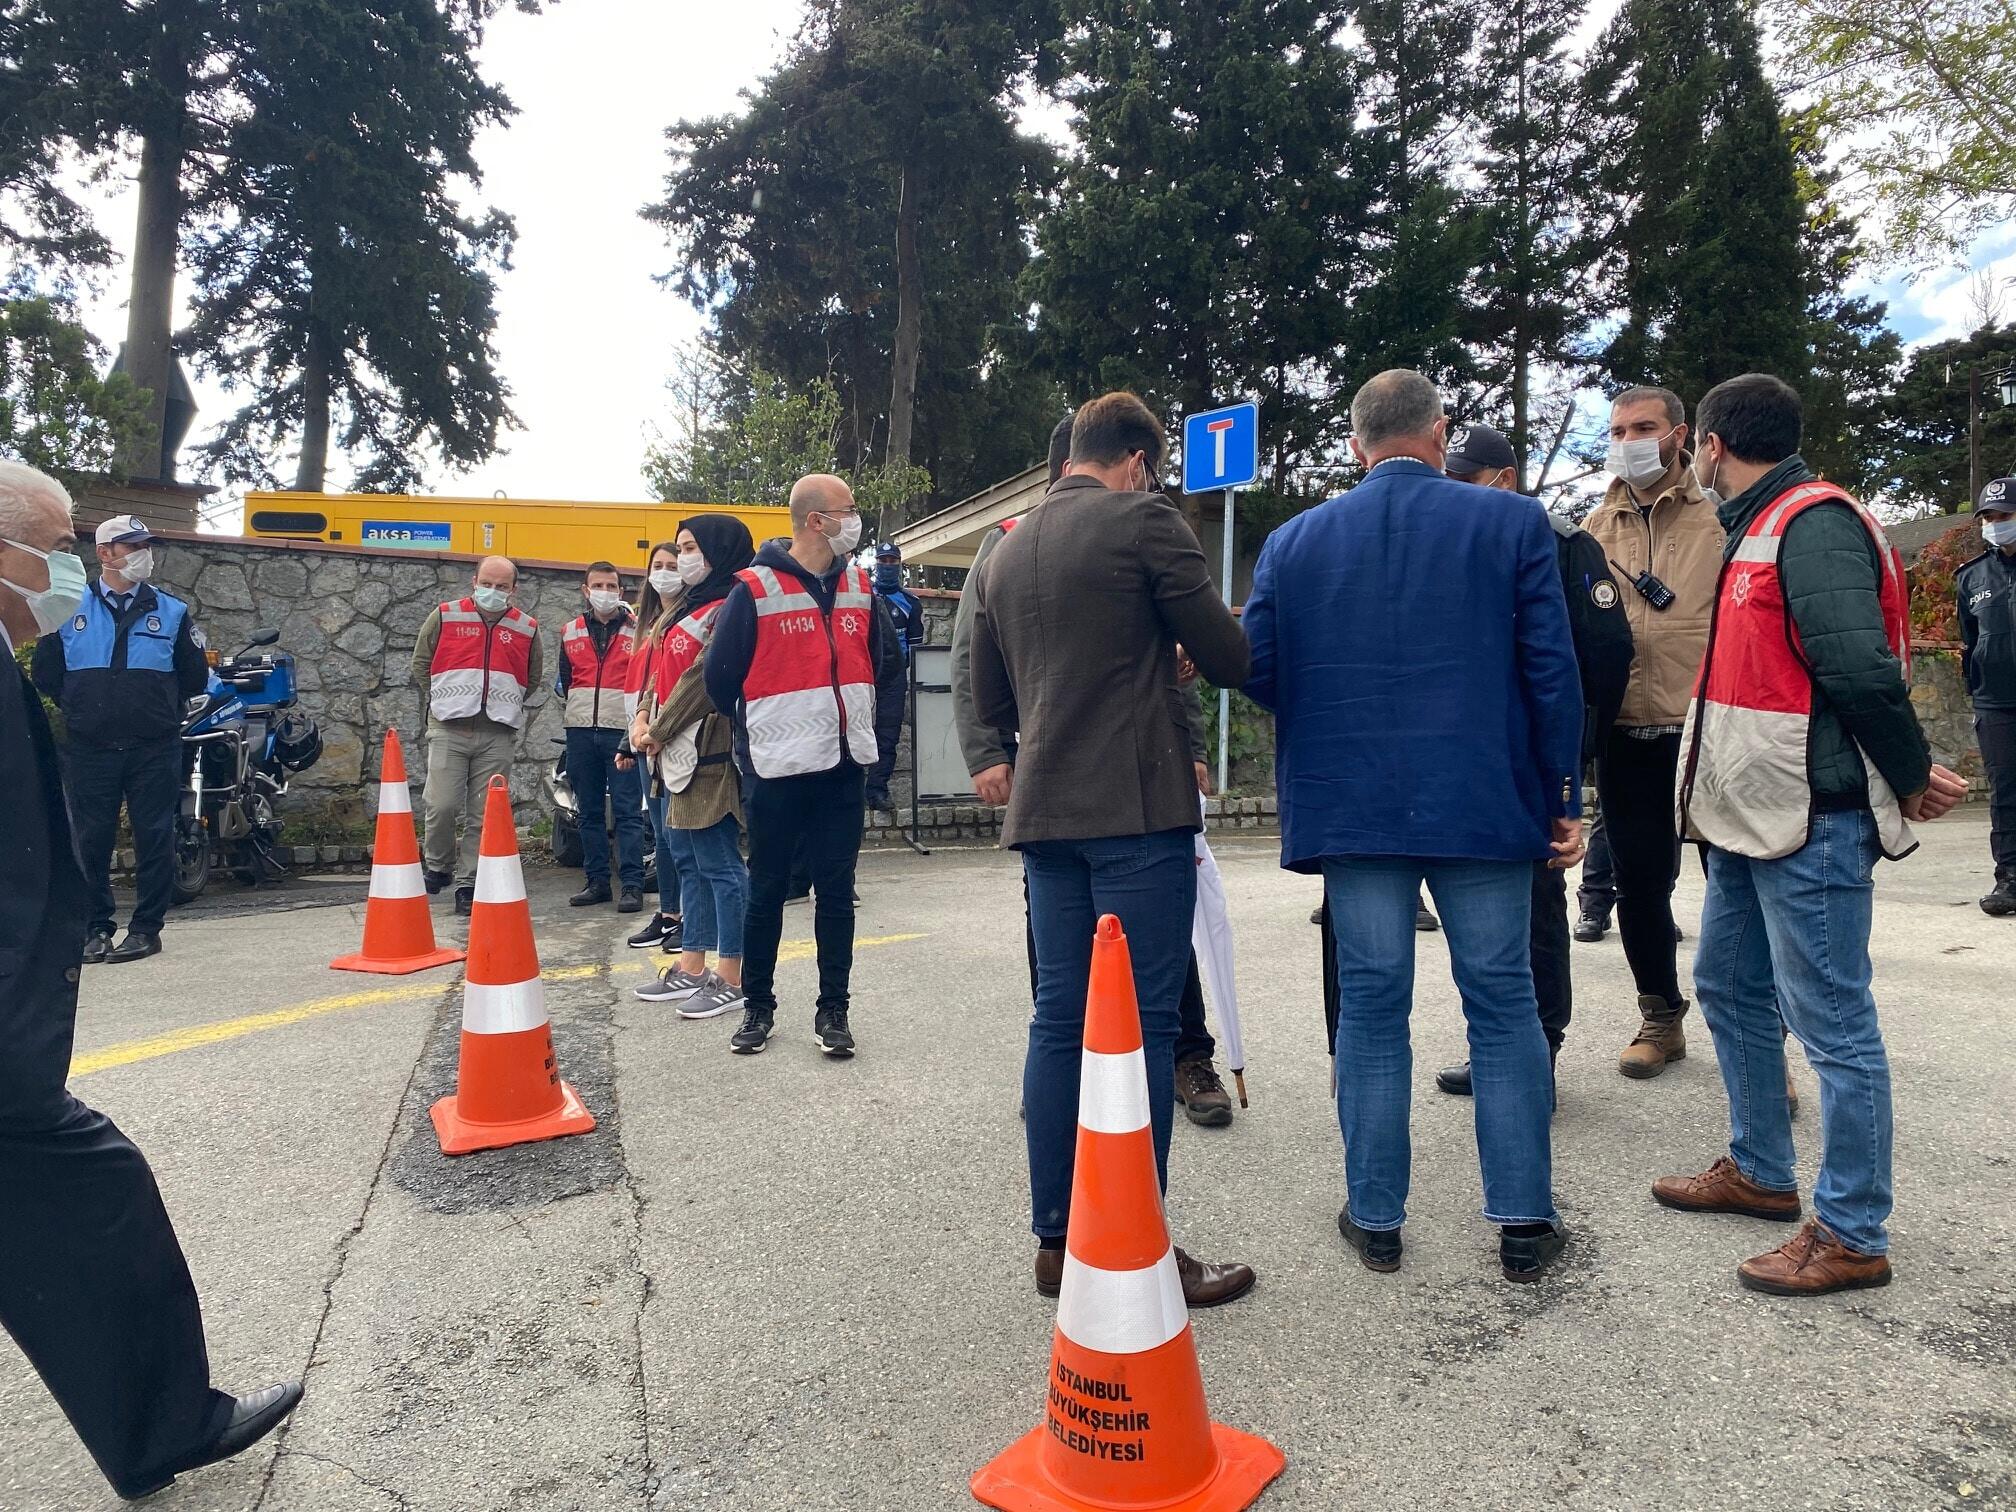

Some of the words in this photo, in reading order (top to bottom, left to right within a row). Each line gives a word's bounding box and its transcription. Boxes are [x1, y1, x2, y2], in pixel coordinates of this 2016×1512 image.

[780, 616, 815, 635] 11-134
[1056, 1356, 1132, 1402] İSTANBUL
[1047, 1411, 1145, 1461] BELEDİYESİ
